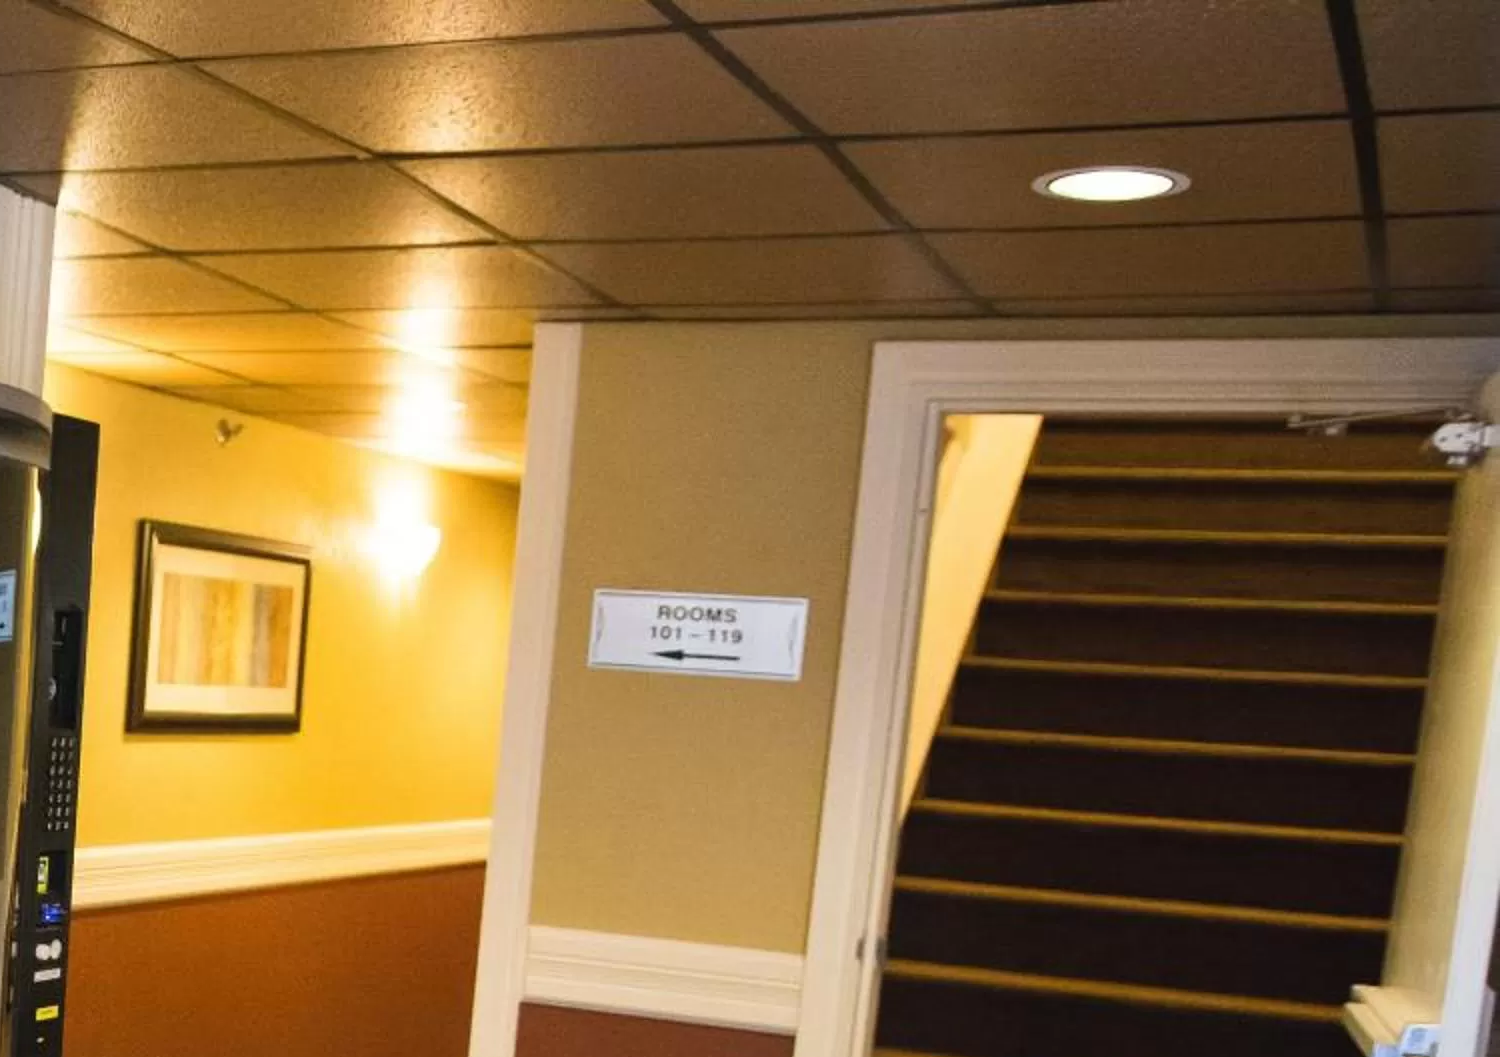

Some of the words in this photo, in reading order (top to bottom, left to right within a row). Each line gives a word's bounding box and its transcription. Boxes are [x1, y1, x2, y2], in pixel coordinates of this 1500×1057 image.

[656, 604, 738, 623] ROOMS
[650, 625, 682, 641] 101
[708, 628, 743, 644] 119
